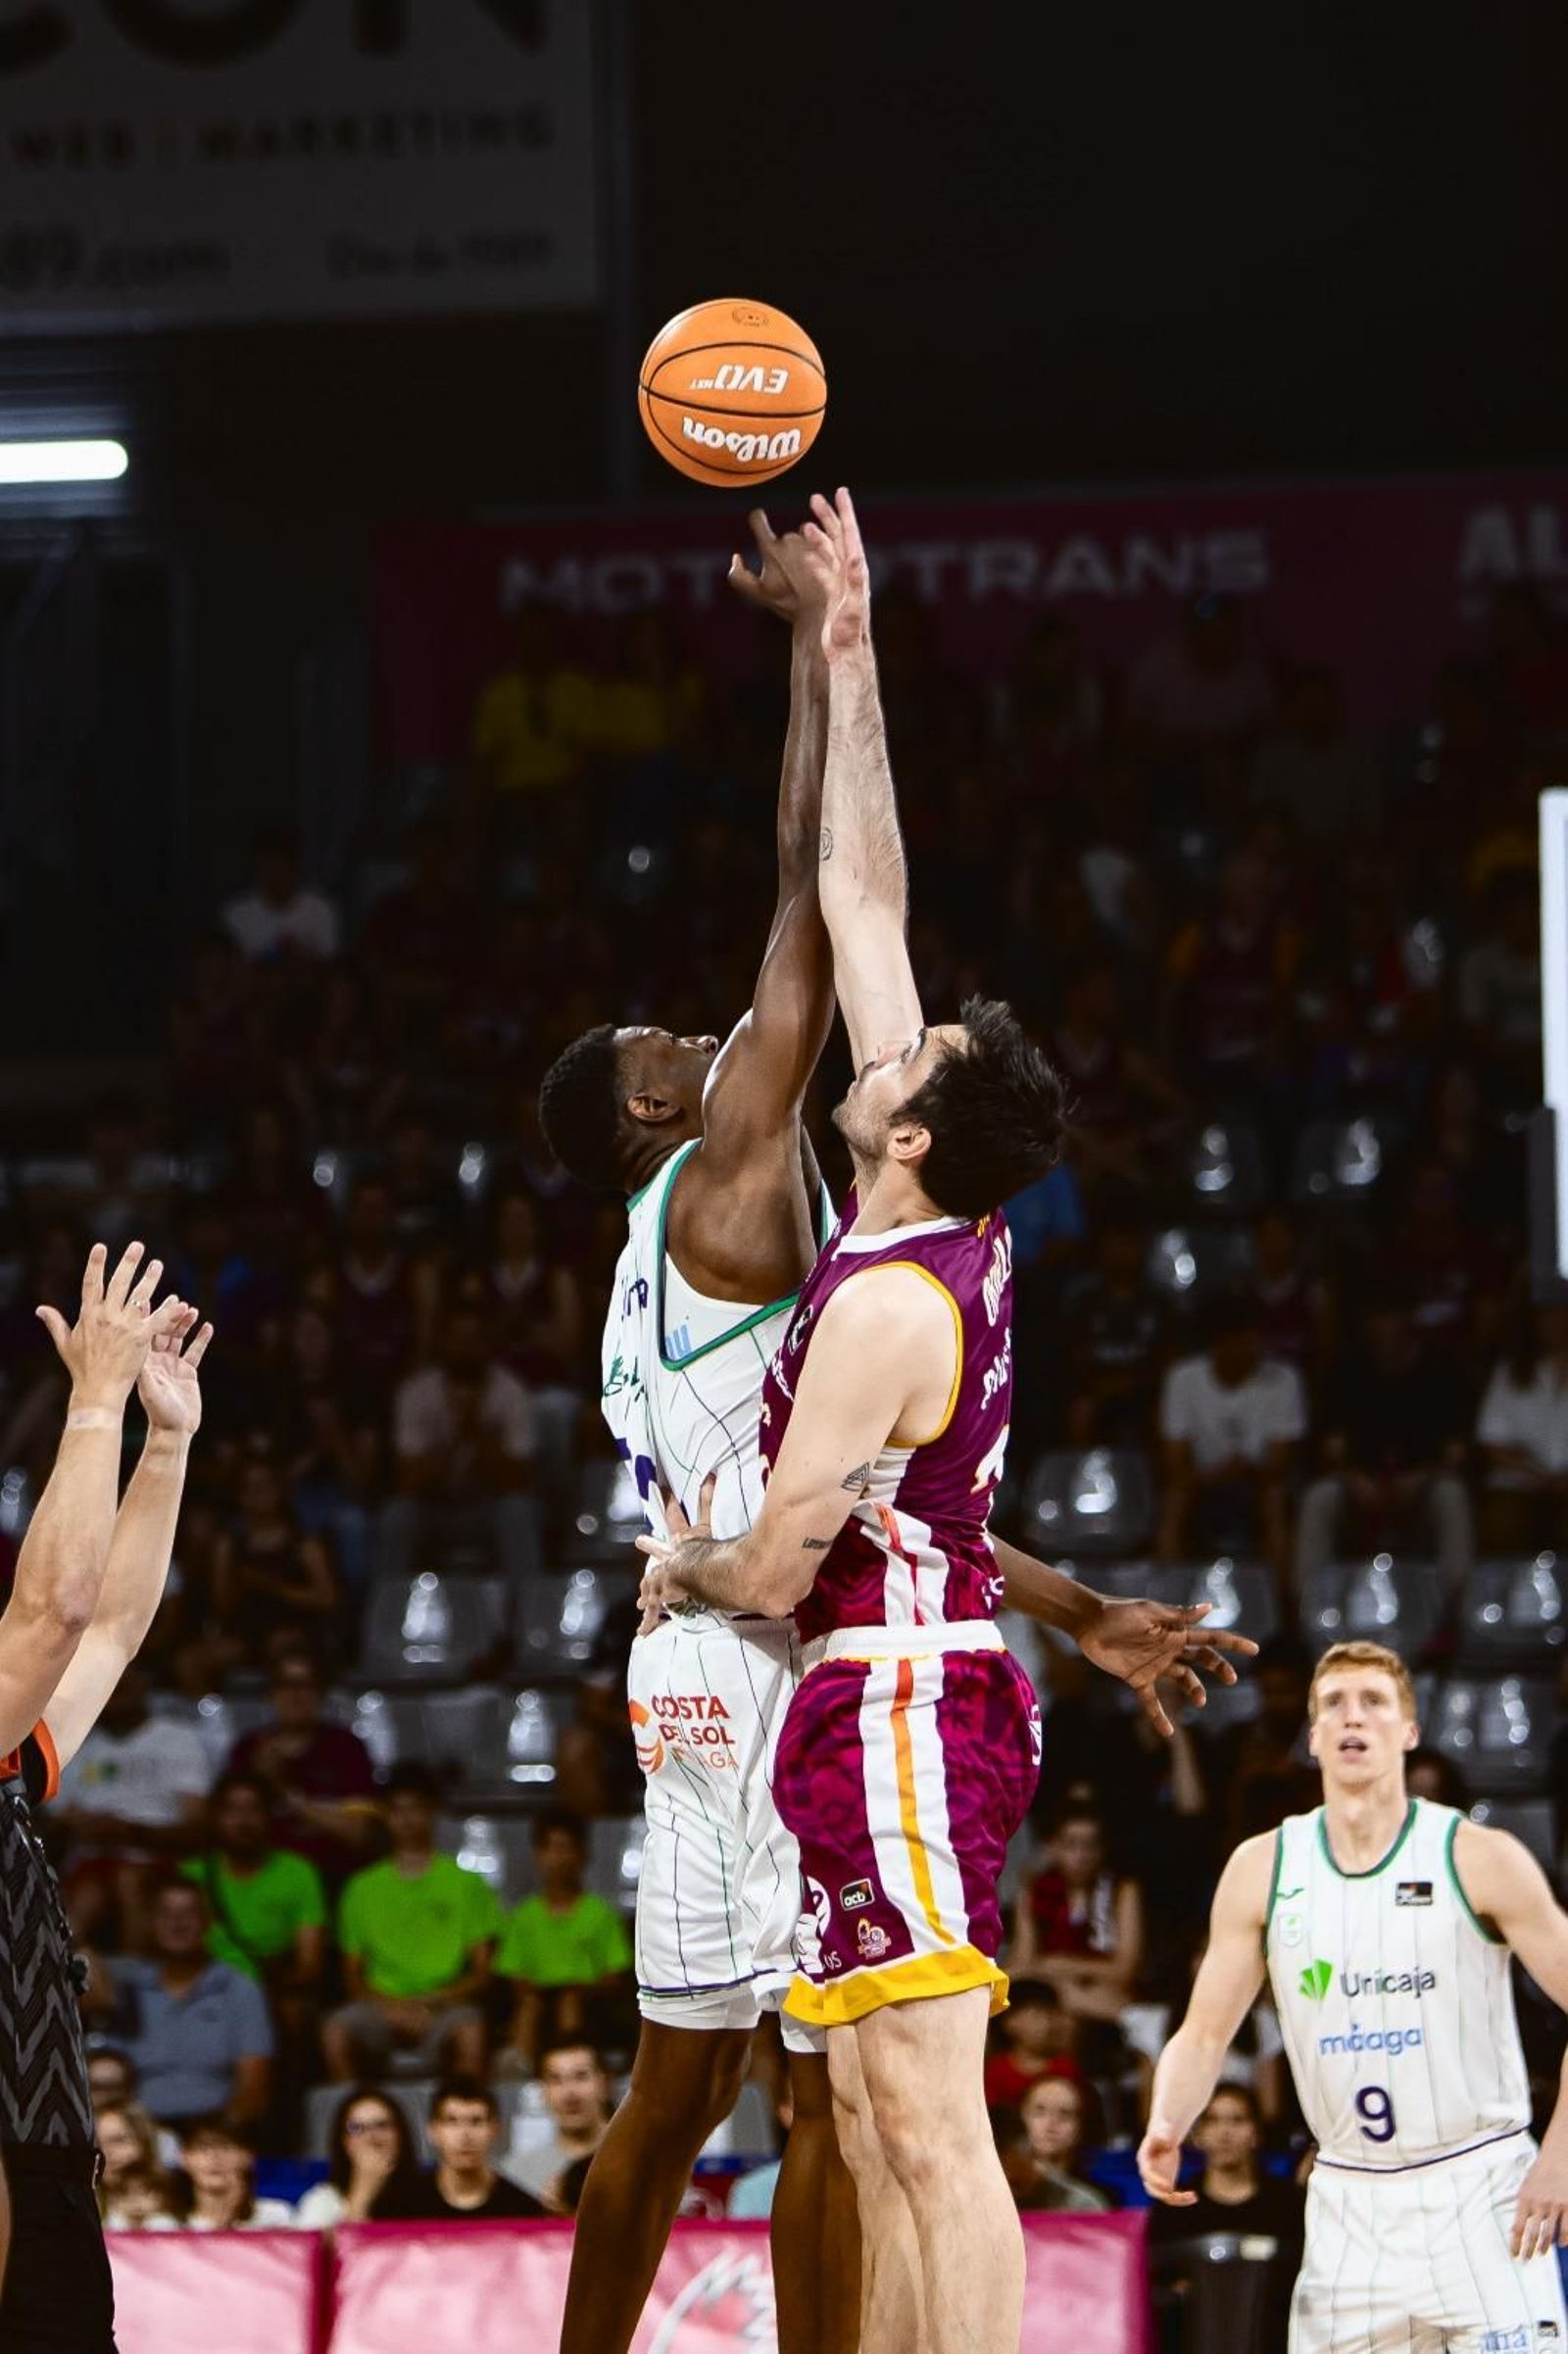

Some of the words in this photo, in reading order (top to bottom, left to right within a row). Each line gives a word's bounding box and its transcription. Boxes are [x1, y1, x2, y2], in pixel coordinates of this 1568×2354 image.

[682, 416, 802, 463] Wilson
[651, 1694, 730, 1720] COSTA
[691, 1726, 735, 1746] SOL
[844, 1891, 865, 1907] acb
[1354, 2085, 1396, 2143] 9
